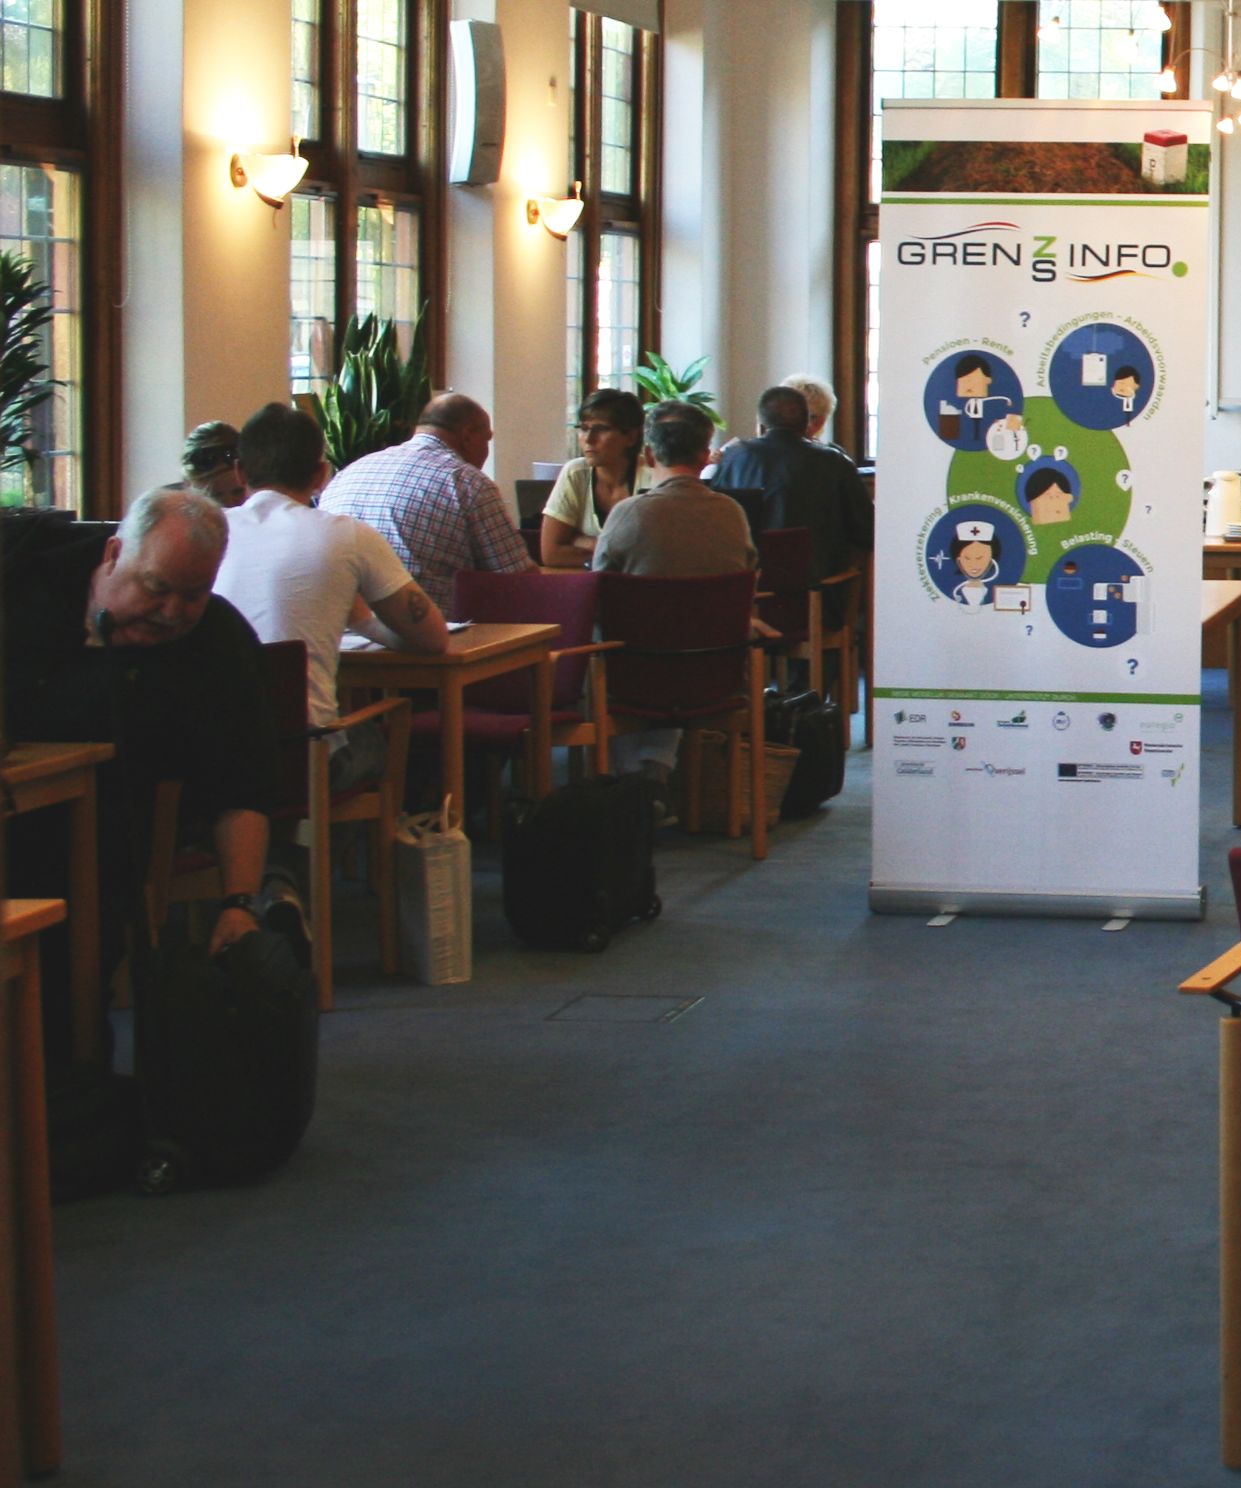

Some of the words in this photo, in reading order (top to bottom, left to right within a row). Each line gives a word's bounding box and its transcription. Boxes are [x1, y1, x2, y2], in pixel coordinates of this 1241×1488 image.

[922, 337, 970, 365] Pensioen
[981, 337, 1015, 356] Rente
[1036, 311, 1114, 387] Arbeitsbedingungen
[949, 491, 1038, 555] Krankenversicherung
[1060, 531, 1113, 550] Belasting
[1122, 539, 1154, 573] Steuern
